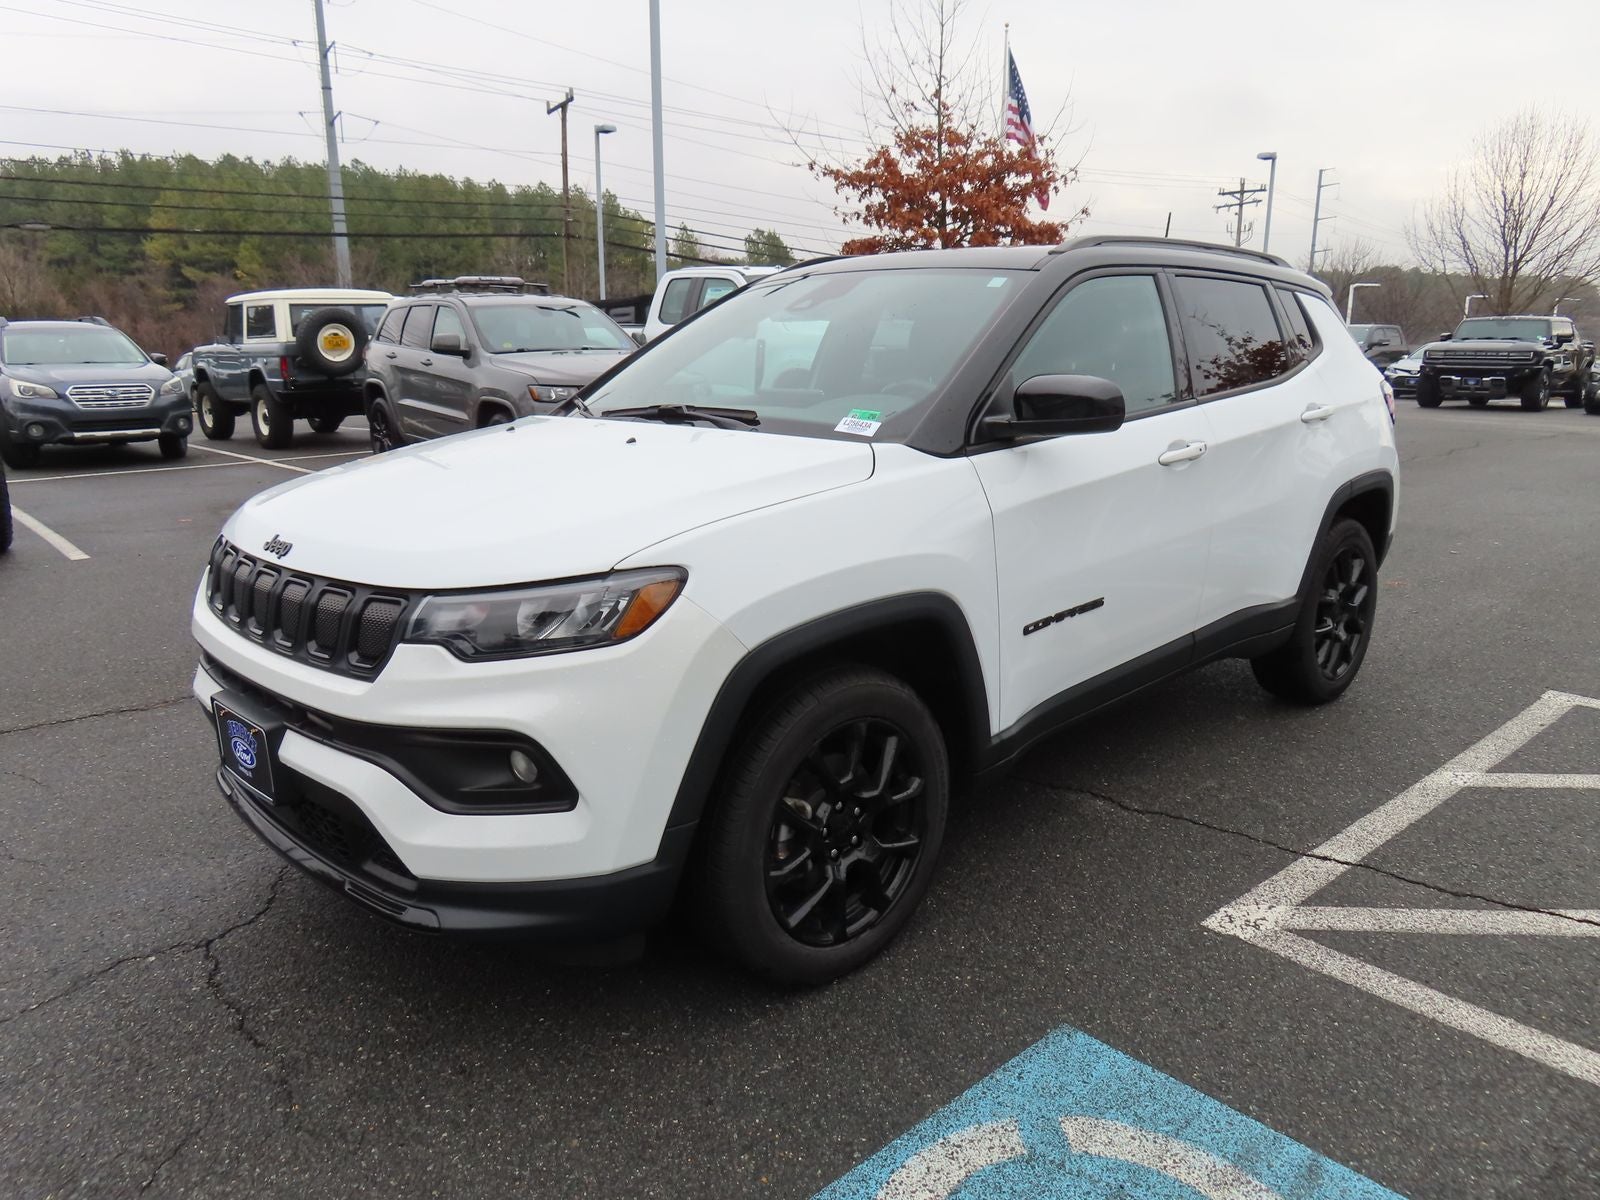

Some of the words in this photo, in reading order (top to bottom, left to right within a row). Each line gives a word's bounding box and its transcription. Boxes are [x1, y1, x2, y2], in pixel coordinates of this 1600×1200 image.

[263, 534, 293, 560] Jeep
[1023, 597, 1105, 636] COMPASS
[235, 741, 253, 765] Ford
